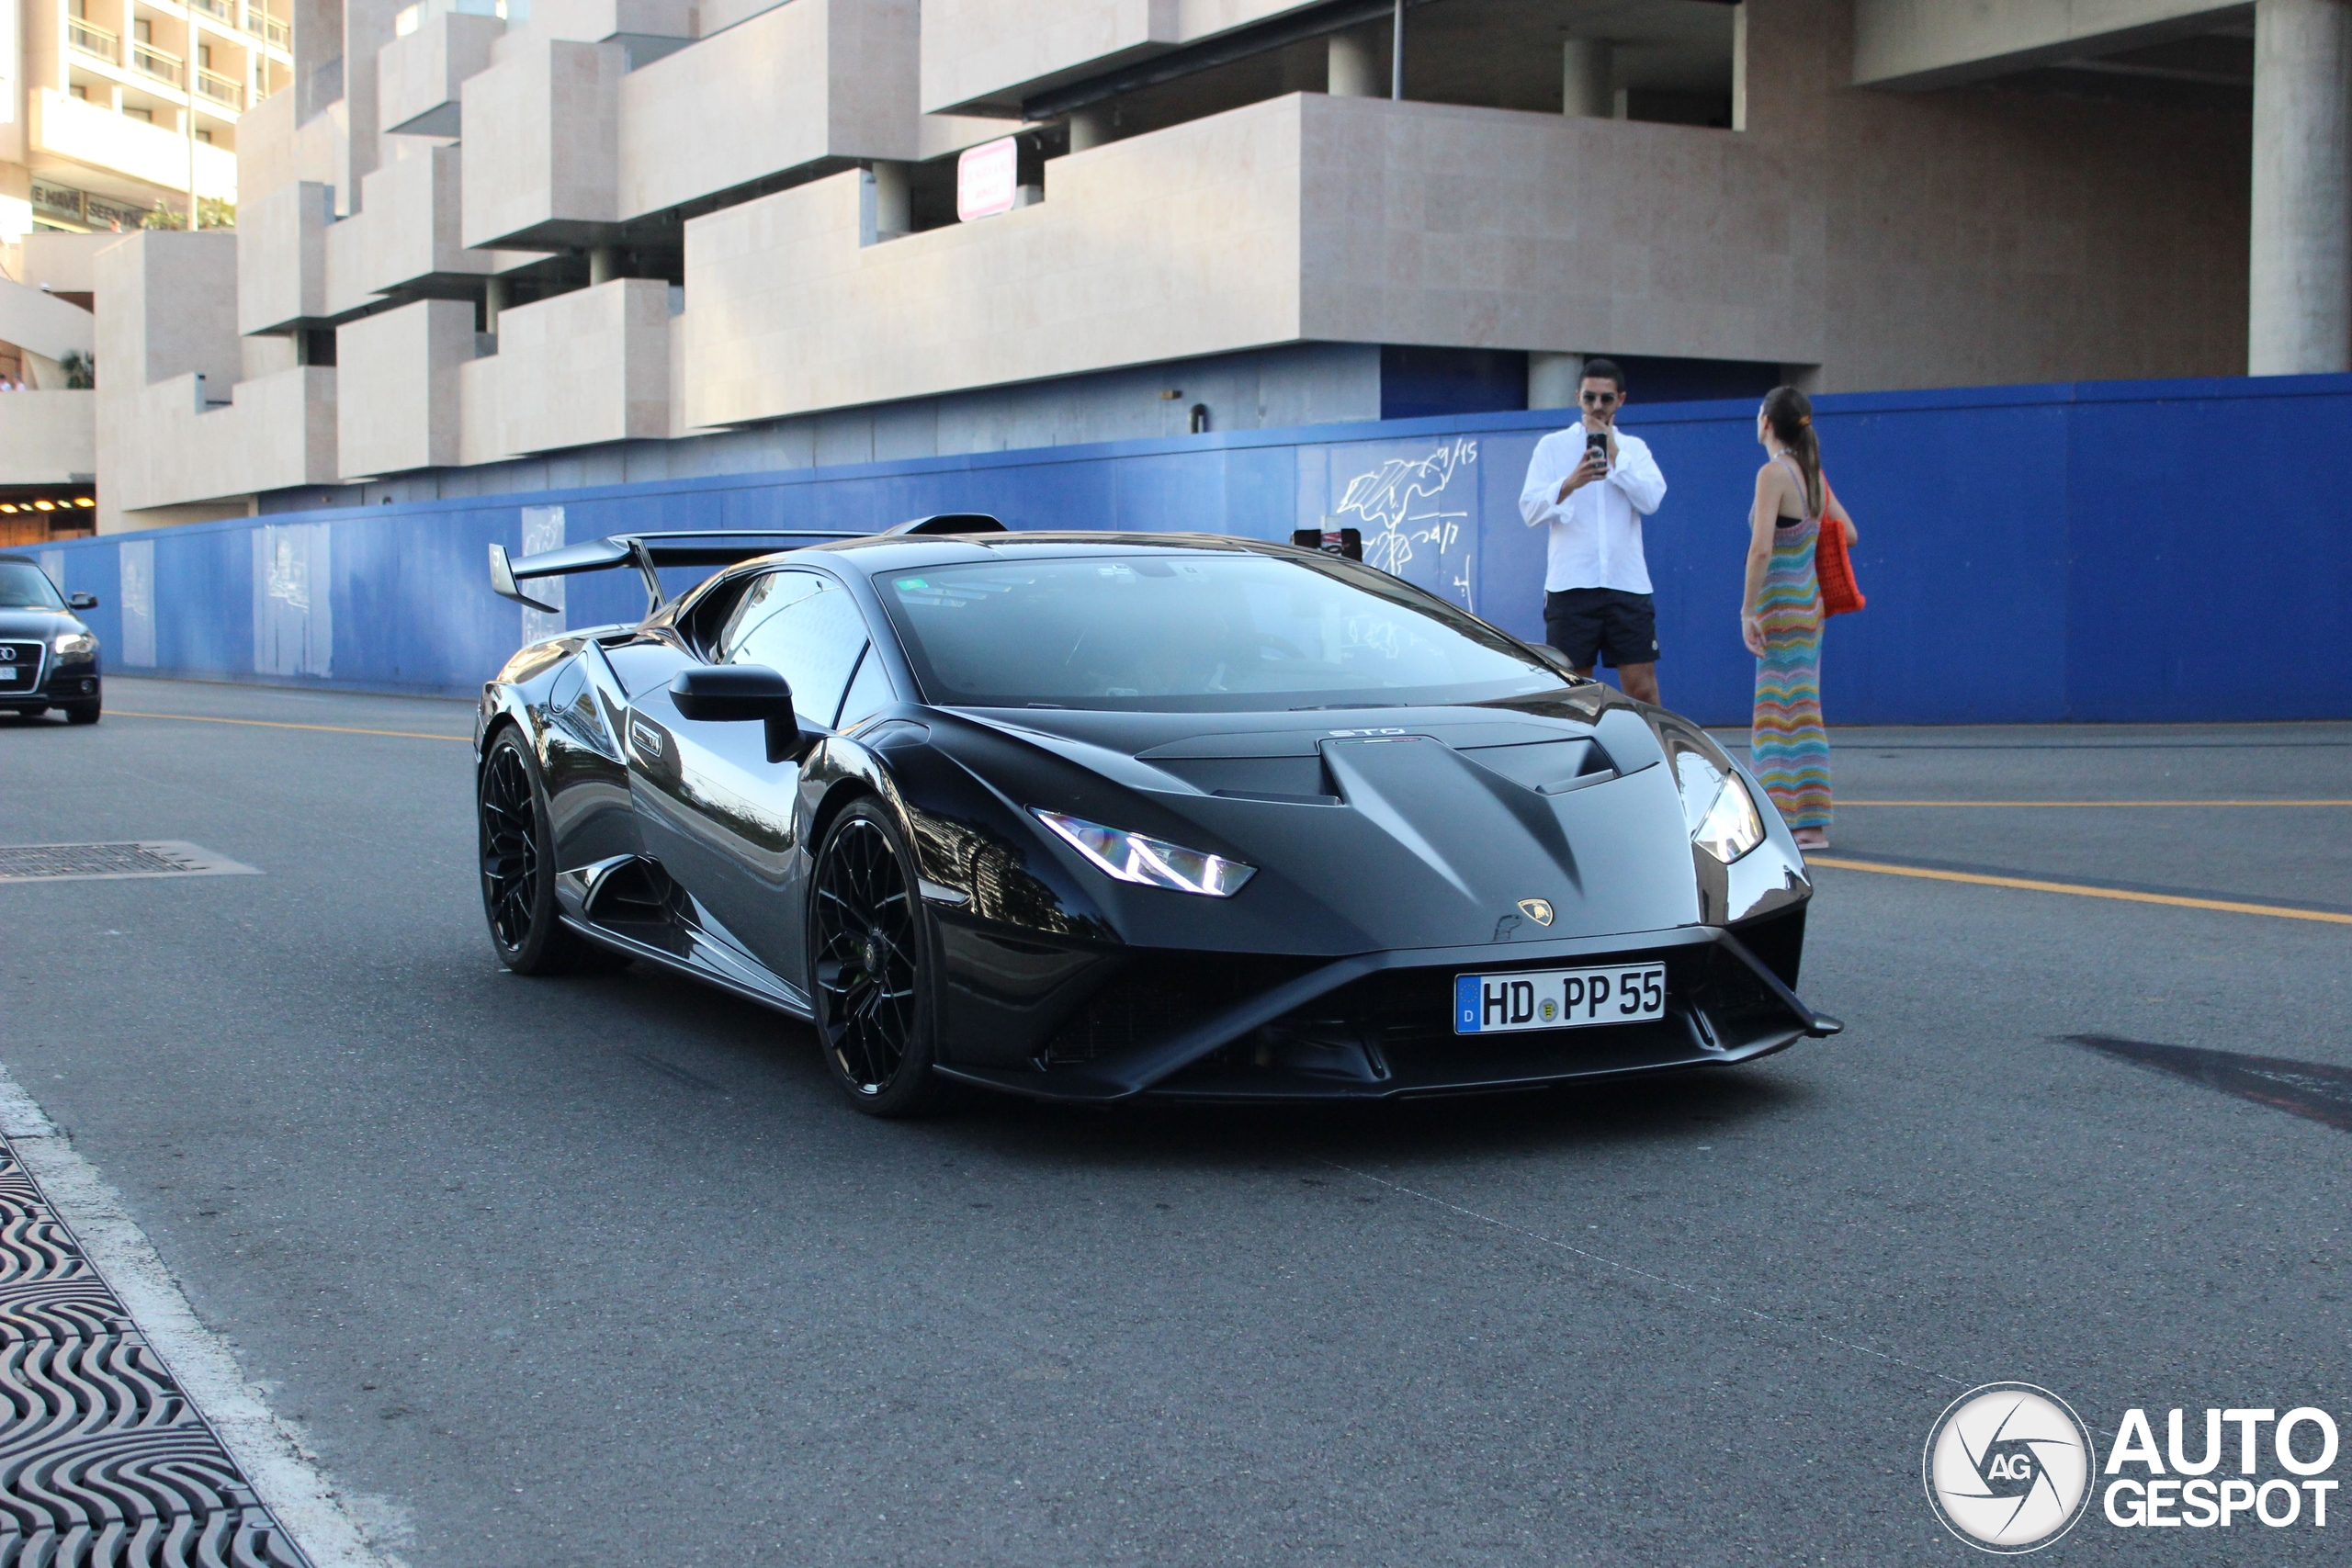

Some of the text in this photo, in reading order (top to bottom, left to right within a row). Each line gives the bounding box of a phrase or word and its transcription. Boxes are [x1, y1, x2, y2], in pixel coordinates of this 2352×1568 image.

[1329, 728, 1406, 738] STO
[1484, 970, 1662, 1026] HD PP 55
[1464, 1010, 1474, 1022] D
